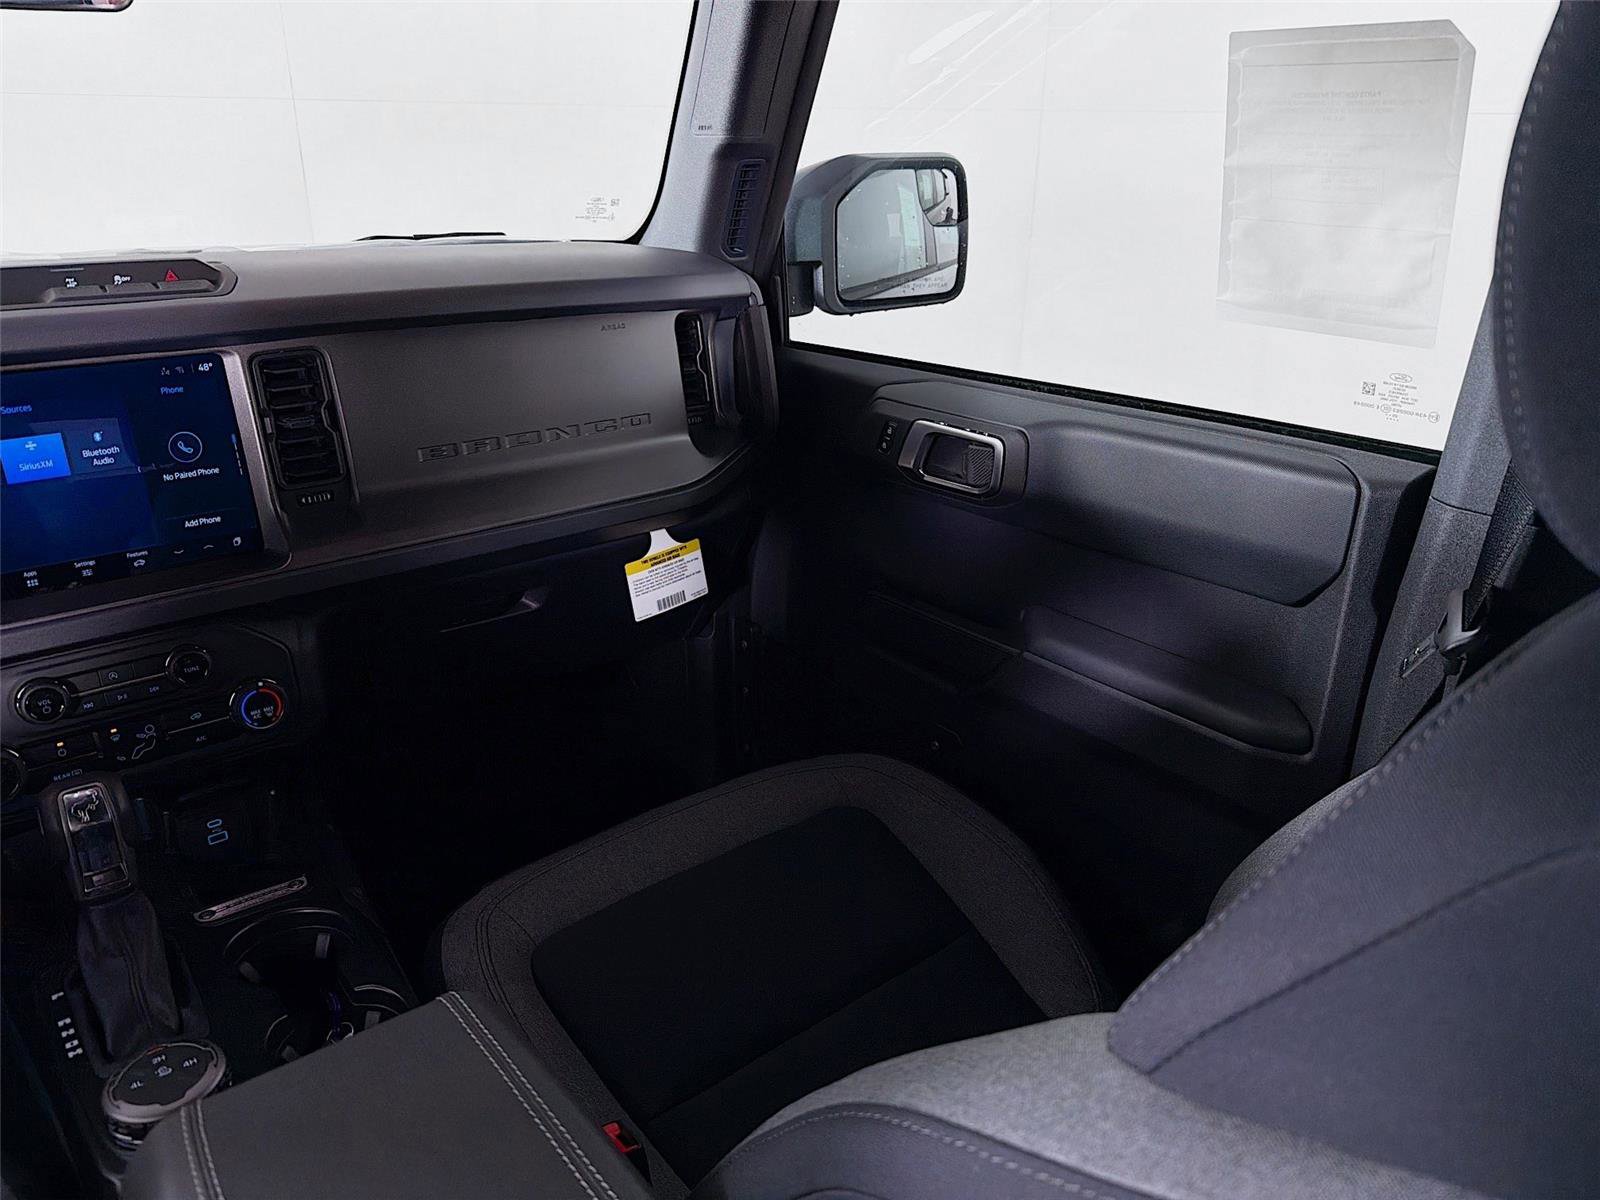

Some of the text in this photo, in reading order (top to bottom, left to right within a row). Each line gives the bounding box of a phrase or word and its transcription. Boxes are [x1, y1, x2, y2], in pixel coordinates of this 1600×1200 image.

[160, 386, 184, 395] Phone
[0, 404, 33, 415] Sources
[417, 412, 652, 464] BRONCO
[82, 445, 120, 458] Bluetooth
[18, 460, 54, 472] SiriusXM
[92, 456, 115, 467] Audio
[163, 467, 220, 482] No Paired Phone
[184, 516, 222, 529] Add Phone
[126, 550, 149, 559] Features
[74, 559, 96, 569] Settings
[23, 570, 38, 578] Apps
[37, 698, 52, 706] VOL
[195, 735, 208, 743] A/C
[183, 1056, 198, 1068] 4H
[129, 1080, 144, 1090] 4L
